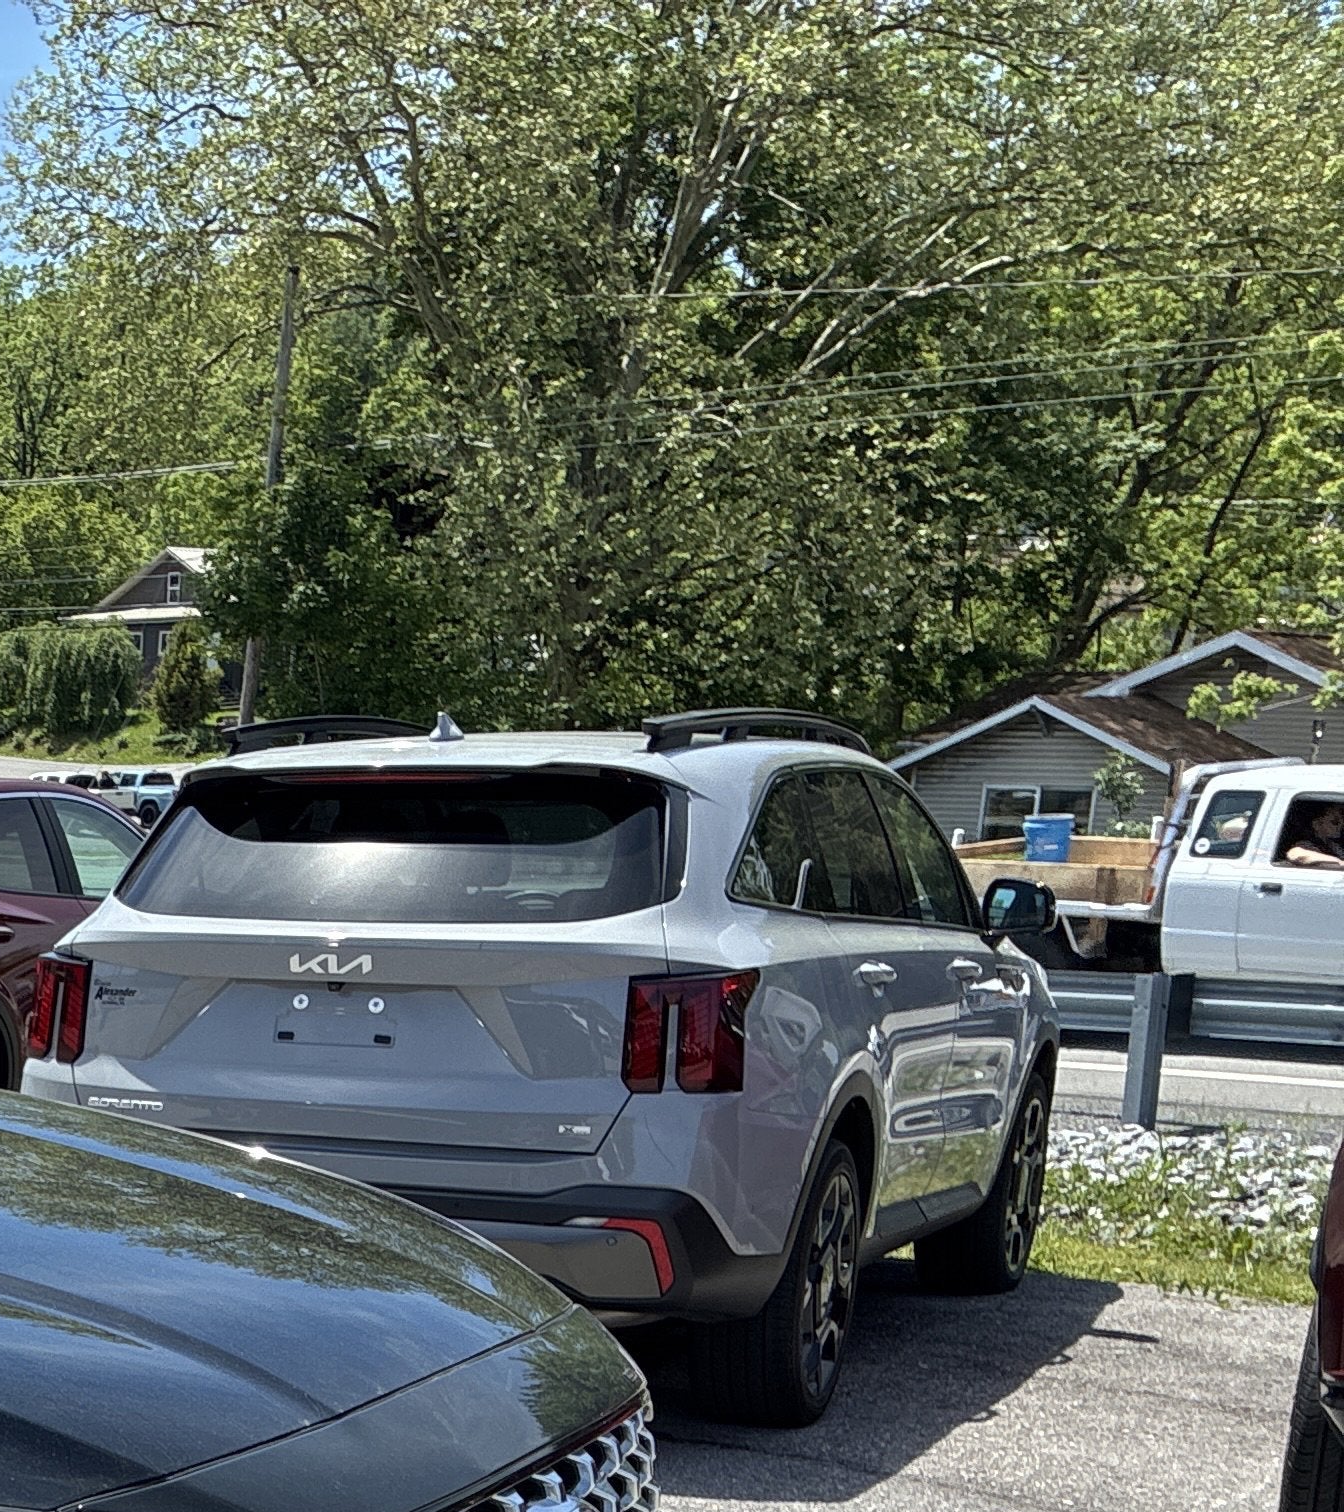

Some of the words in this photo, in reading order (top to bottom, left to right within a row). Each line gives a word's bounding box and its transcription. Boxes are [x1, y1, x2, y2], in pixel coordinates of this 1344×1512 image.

[289, 953, 372, 975] KIA
[94, 986, 137, 1000] Alexander
[87, 1096, 164, 1112] SORENTO
